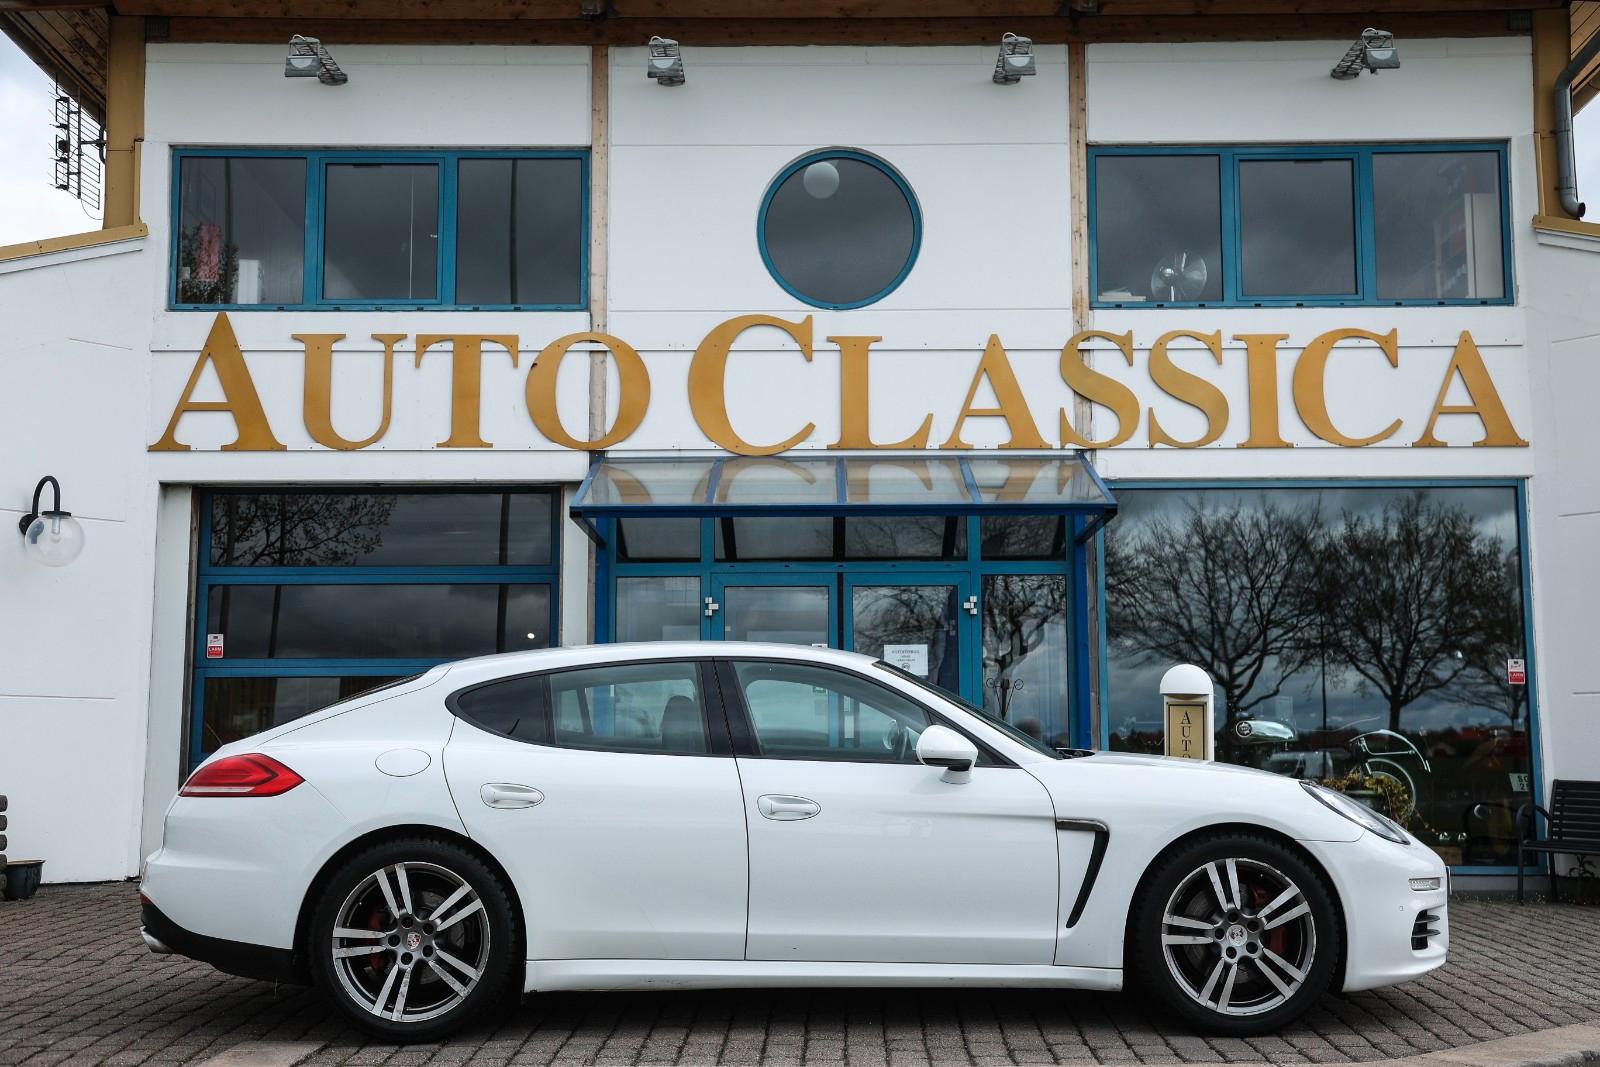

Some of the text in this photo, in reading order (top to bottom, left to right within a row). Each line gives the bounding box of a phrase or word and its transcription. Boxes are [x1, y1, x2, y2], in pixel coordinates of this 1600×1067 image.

[148, 311, 1529, 457] AUTO CLASSICA
[1180, 711, 1192, 758] AUT
